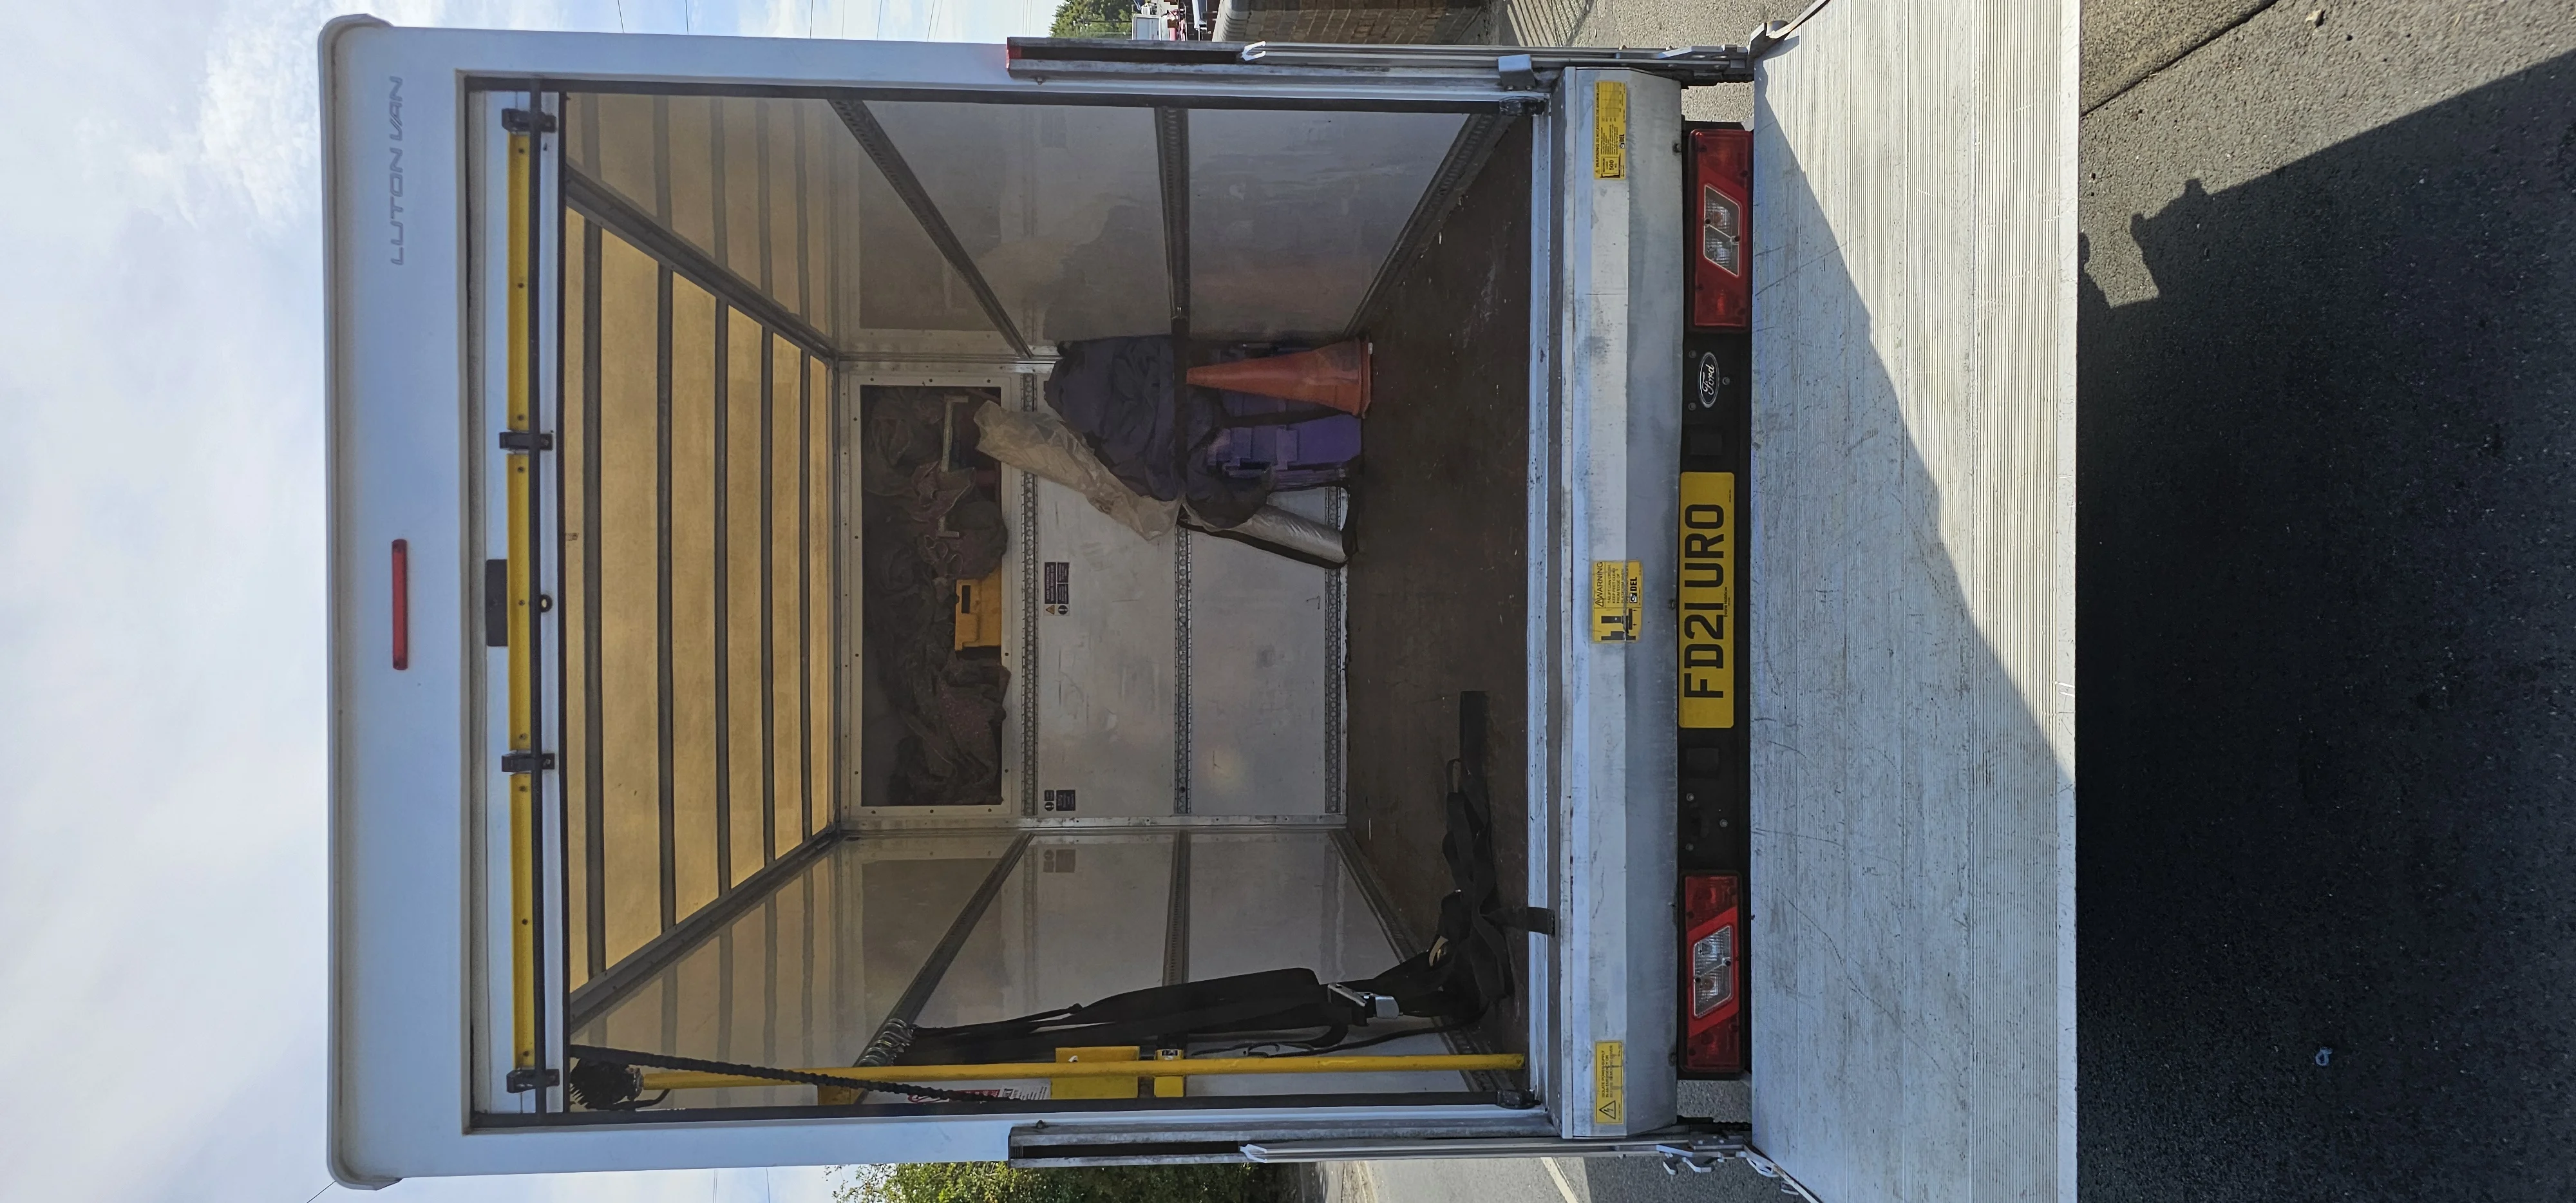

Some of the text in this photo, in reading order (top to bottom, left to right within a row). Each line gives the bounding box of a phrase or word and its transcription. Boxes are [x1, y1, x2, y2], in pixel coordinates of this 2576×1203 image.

[389, 77, 404, 265] LUTON VAN
[1702, 363, 1714, 395] Ford
[1684, 504, 1724, 699] FD21 URO
